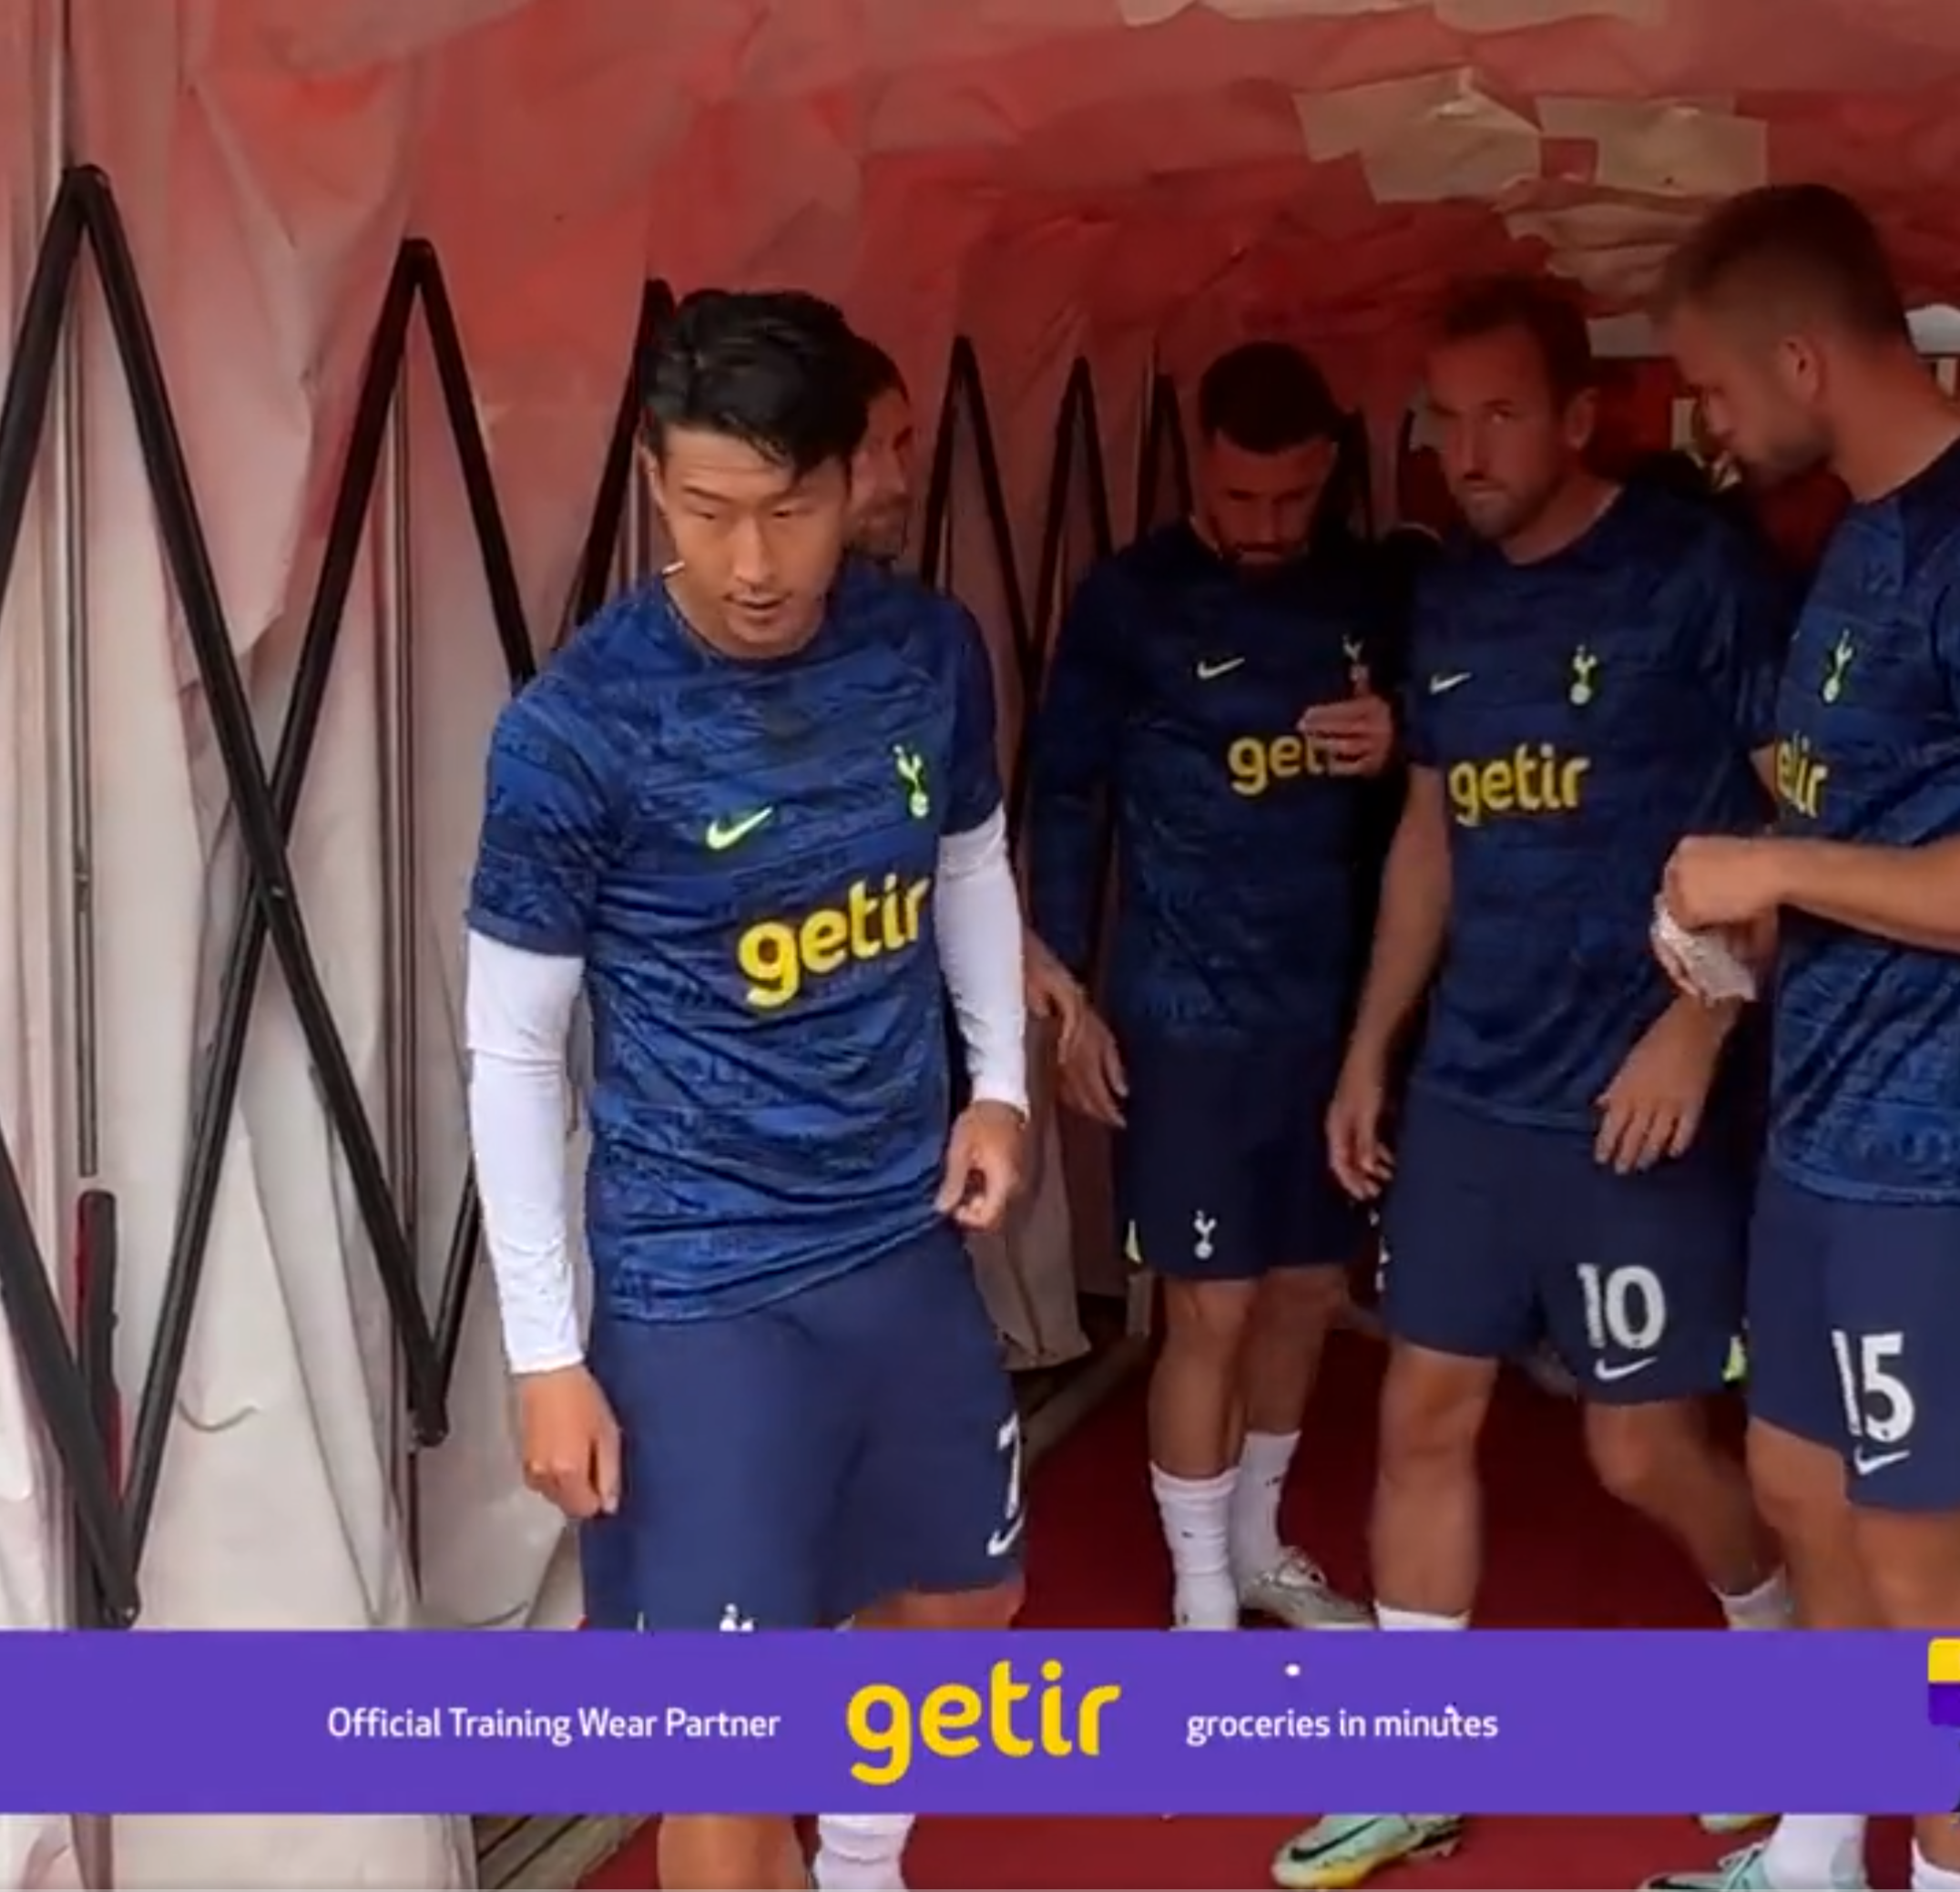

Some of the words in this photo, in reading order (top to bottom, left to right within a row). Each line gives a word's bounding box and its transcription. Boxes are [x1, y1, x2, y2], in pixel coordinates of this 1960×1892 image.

[1228, 735, 1325, 795] get
[1448, 742, 1591, 827] getir
[1777, 730, 1828, 819] etir
[737, 873, 931, 1008] getir
[1577, 1263, 1666, 1350] 10
[1832, 1330, 1914, 1444] 15
